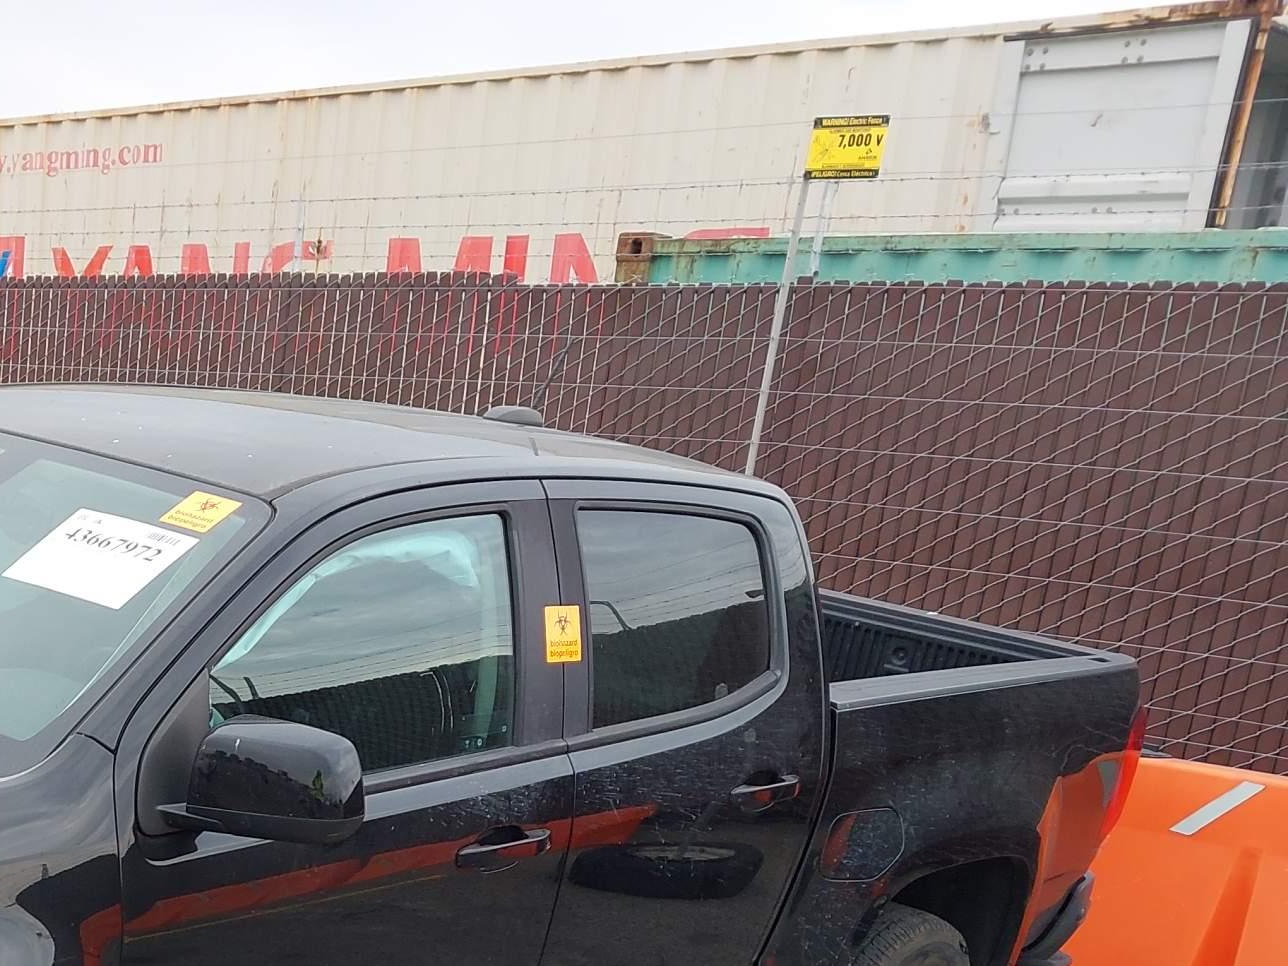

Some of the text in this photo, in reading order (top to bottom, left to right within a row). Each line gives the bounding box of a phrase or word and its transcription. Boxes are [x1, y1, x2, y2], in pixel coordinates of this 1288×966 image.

[838, 133, 884, 149] 7,000 V
[65, 527, 162, 562] 43667972
